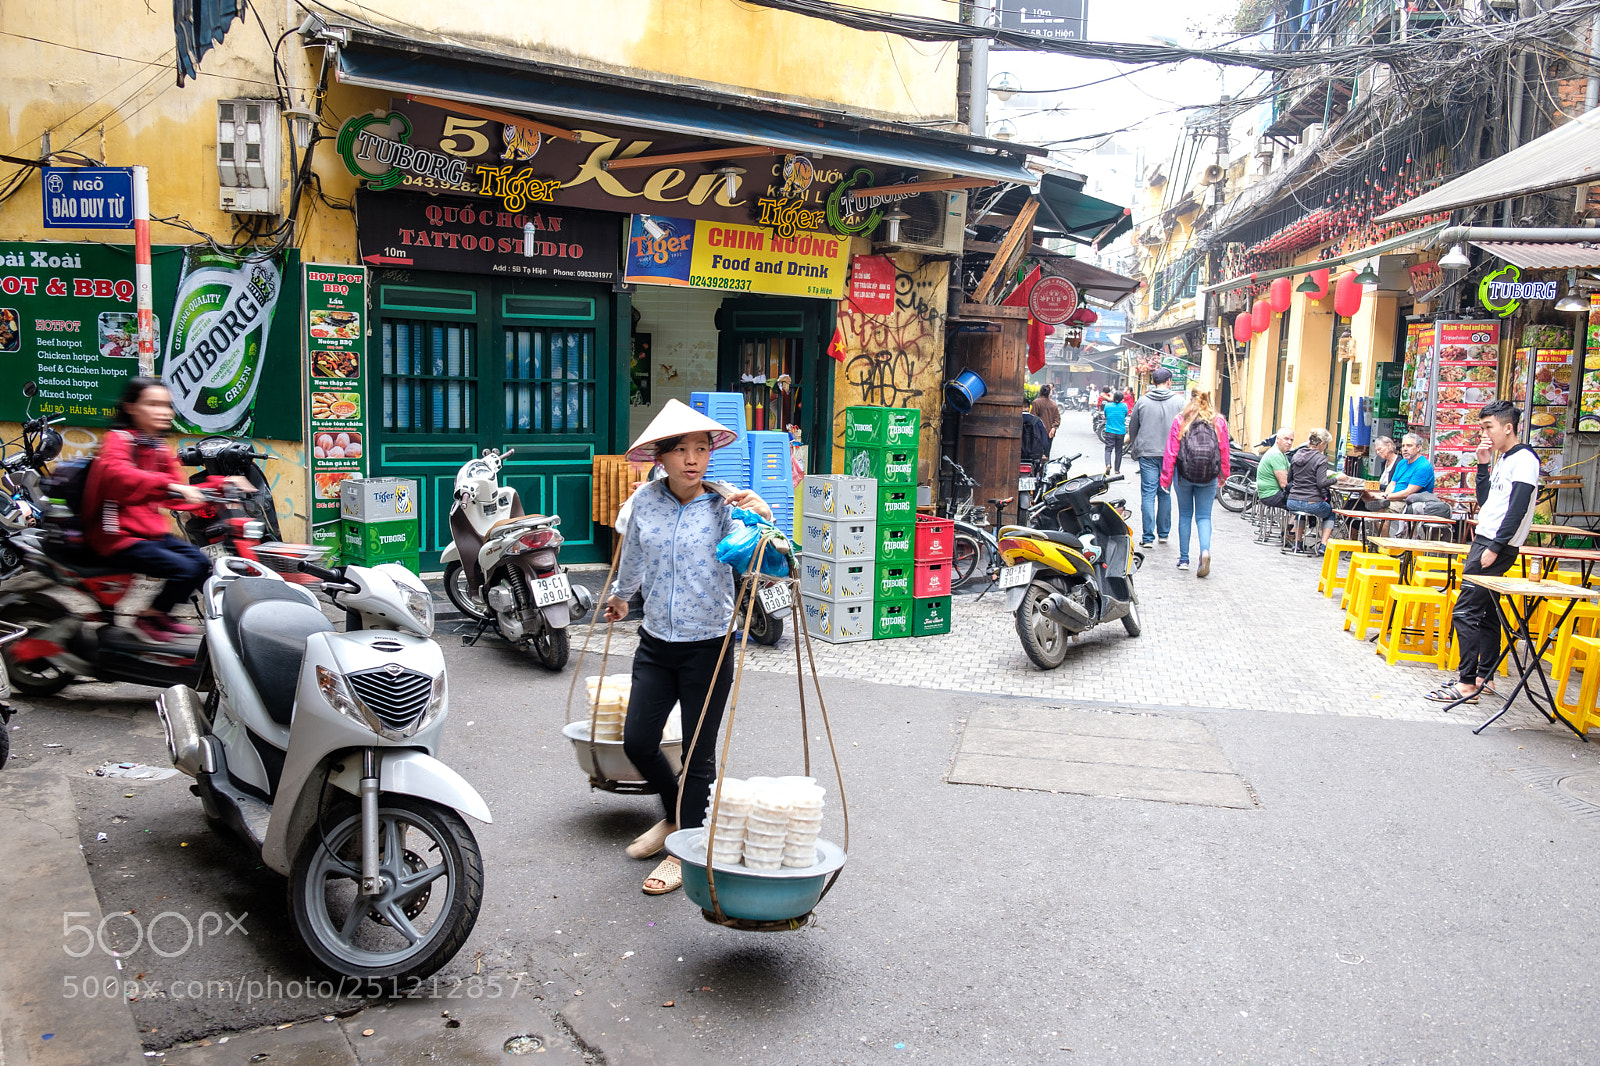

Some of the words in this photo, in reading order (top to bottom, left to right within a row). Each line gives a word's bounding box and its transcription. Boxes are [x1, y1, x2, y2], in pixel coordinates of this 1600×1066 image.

[440, 116, 490, 157] 5
[358, 130, 467, 185] TUBORG
[73, 179, 104, 191] NGÕ
[476, 165, 561, 212] Tiger
[52, 195, 78, 218] ĐÀO
[80, 196, 105, 218] DUY
[107, 196, 125, 218] TỪ
[757, 198, 825, 239] Tiger
[399, 227, 495, 252] TATTOO
[498, 237, 584, 259] STUDIO
[631, 229, 691, 263] Tiger
[708, 227, 765, 251] CHIM
[770, 233, 839, 259] NƯỚNG
[384, 247, 407, 258] 10m
[30, 251, 82, 268] Xoài
[553, 268, 576, 277] Phone:
[712, 254, 750, 271] Food
[754, 257, 783, 275] and
[786, 261, 829, 279] Drink
[309, 272, 335, 282] HOT
[337, 274, 362, 284] POT
[689, 275, 752, 291] 02439282337
[0, 276, 39, 295] OT
[46, 277, 67, 296] &
[73, 278, 135, 303] BBQ
[323, 284, 349, 296] BBQ
[1489, 281, 1557, 300] TUBORG
[188, 293, 222, 312] QUALITY
[35, 319, 81, 333] HOTPOT
[175, 309, 191, 351] GENUINE
[37, 337, 56, 346] Beef
[56, 339, 83, 349] hotpot
[169, 290, 260, 400] TUBORG
[37, 350, 71, 360] Chicken
[73, 352, 99, 363] hotpot
[38, 363, 56, 372] Beef
[57, 364, 64, 373] &
[65, 365, 100, 375] Chicken
[101, 366, 128, 377] hotpot
[38, 376, 71, 386] Seafood
[72, 378, 99, 389] hotpot
[224, 365, 252, 403] GREEN
[39, 389, 65, 399] Mixed
[66, 391, 92, 402] hotpot
[854, 423, 873, 432] TUBORG
[888, 425, 914, 435] TUBORG
[886, 464, 912, 473] TUBORG
[373, 491, 395, 503] Tiger
[808, 485, 823, 497] Tiger
[884, 502, 910, 511] TUBORG
[807, 525, 822, 538] Tiger
[379, 533, 406, 545] TUBORG
[883, 540, 909, 550] TUBORG
[806, 565, 820, 577] Tiger
[881, 578, 908, 588] TUBORG
[805, 604, 820, 617] Tiger
[880, 616, 906, 626] TUBORG
